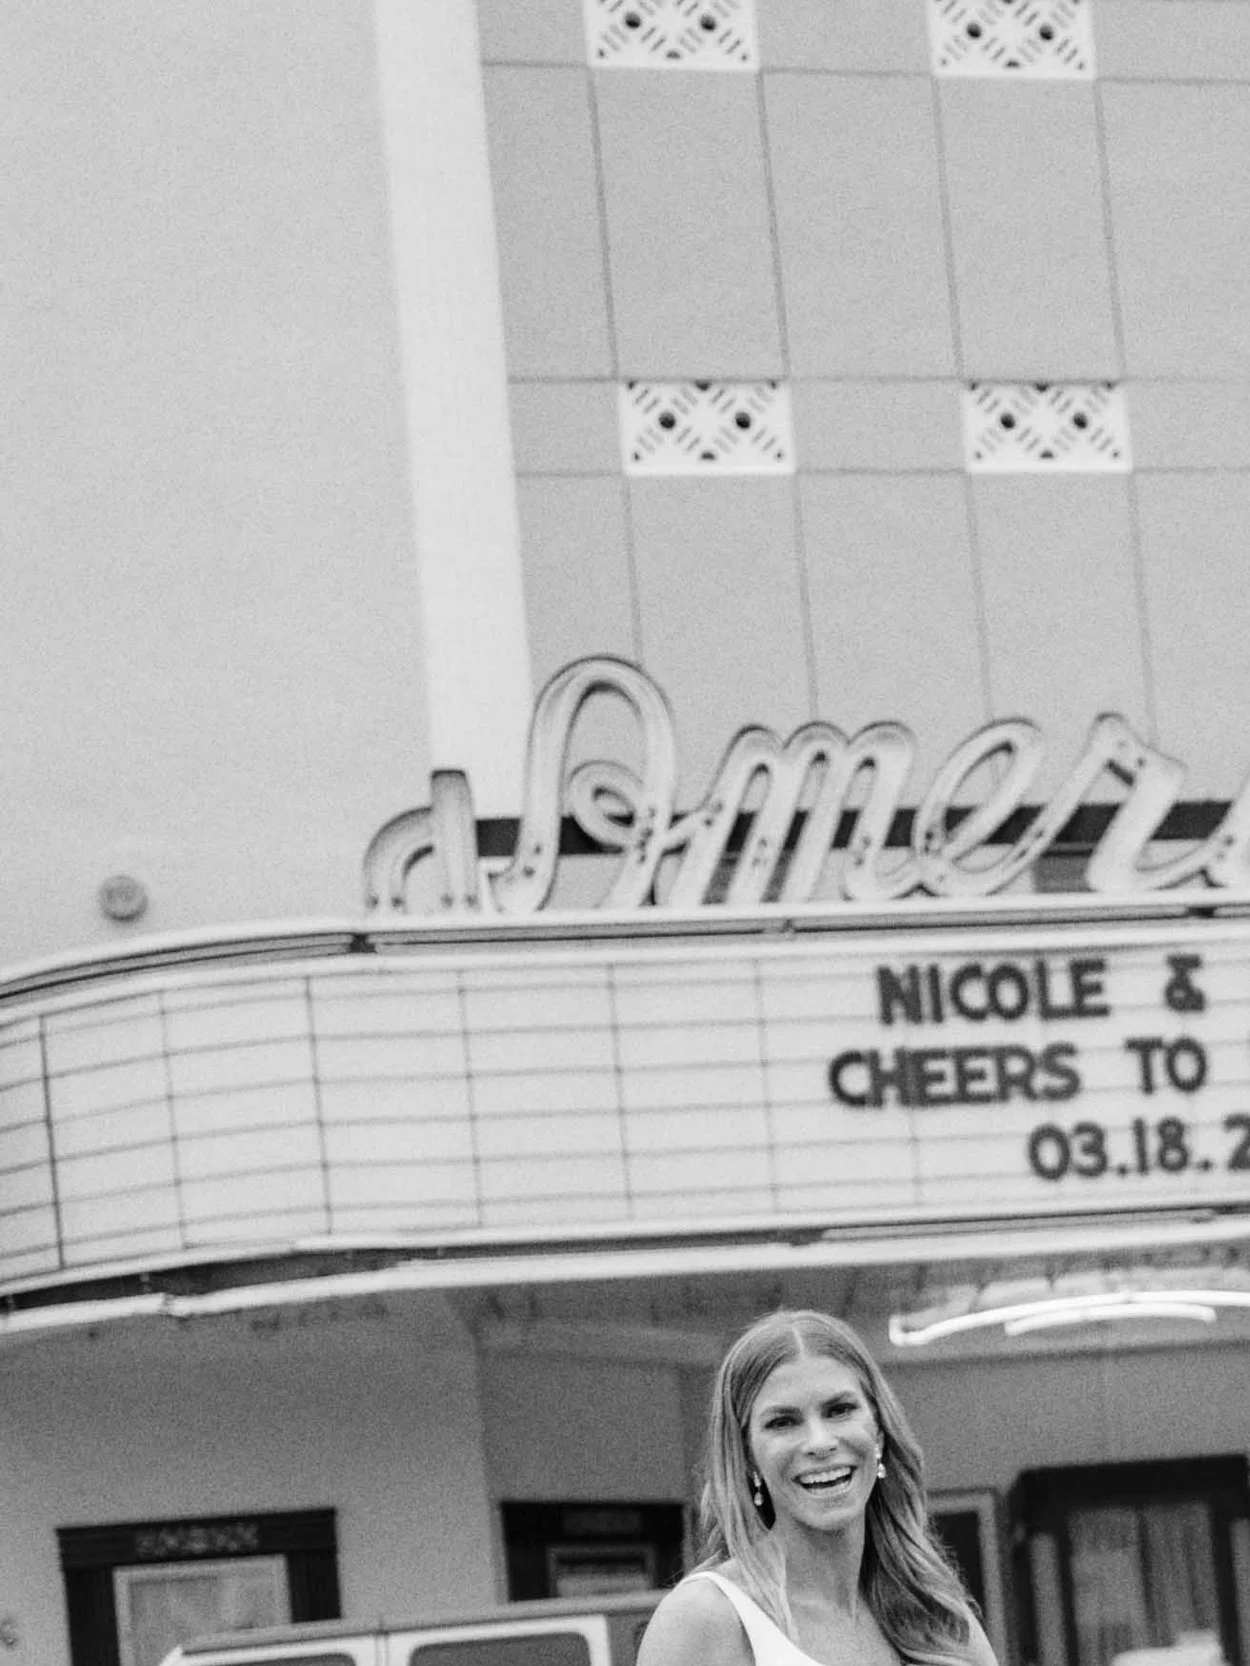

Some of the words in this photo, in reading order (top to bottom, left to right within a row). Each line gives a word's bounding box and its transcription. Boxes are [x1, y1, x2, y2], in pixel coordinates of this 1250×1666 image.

[876, 956, 1110, 1026] NICOLE
[1163, 954, 1208, 1014] &
[827, 1042, 1081, 1109] CHEERS
[1125, 1036, 1208, 1095] TO
